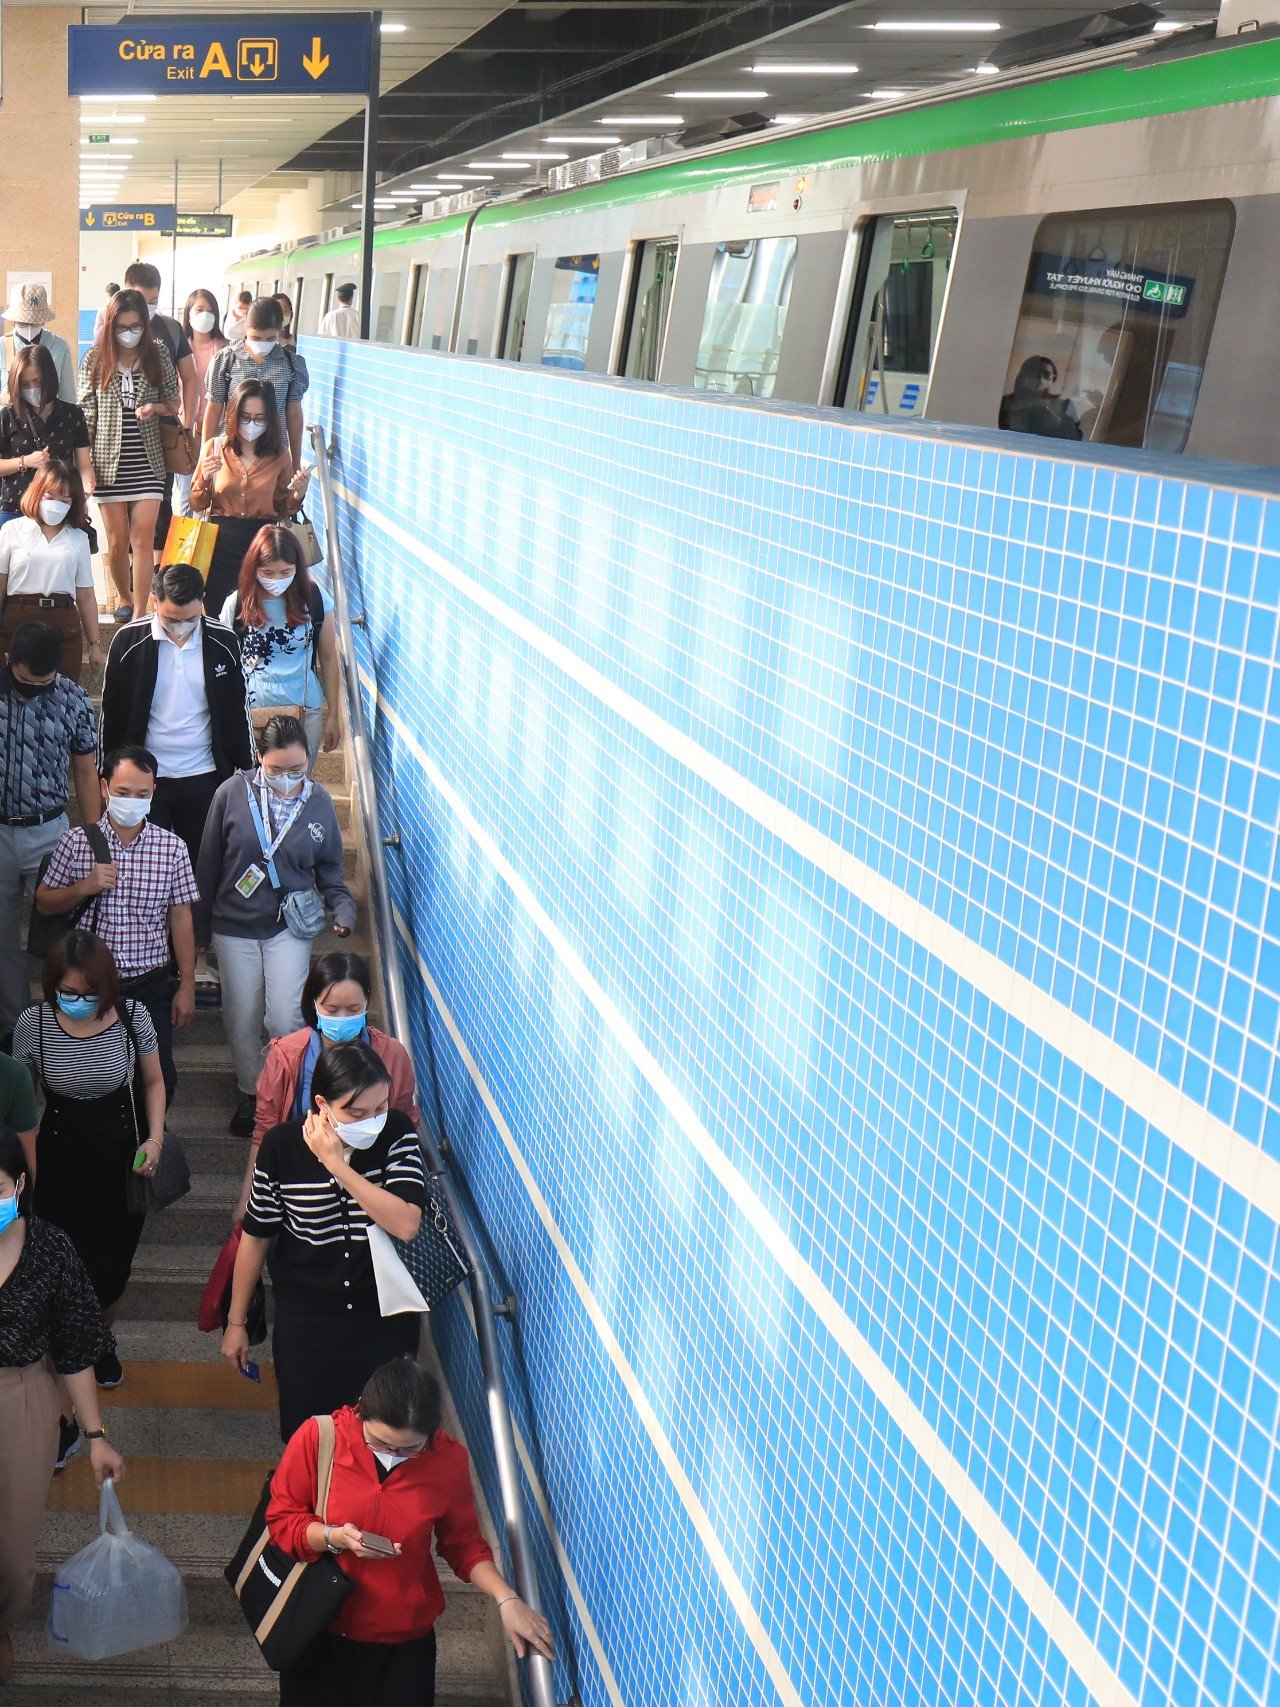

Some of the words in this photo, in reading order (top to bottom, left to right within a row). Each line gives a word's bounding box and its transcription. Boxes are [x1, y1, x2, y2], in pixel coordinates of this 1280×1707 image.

[118, 39, 166, 60] Cửa
[173, 44, 195, 60] ra
[199, 42, 232, 78] A
[166, 66, 195, 80] Exit
[143, 212, 156, 226] B
